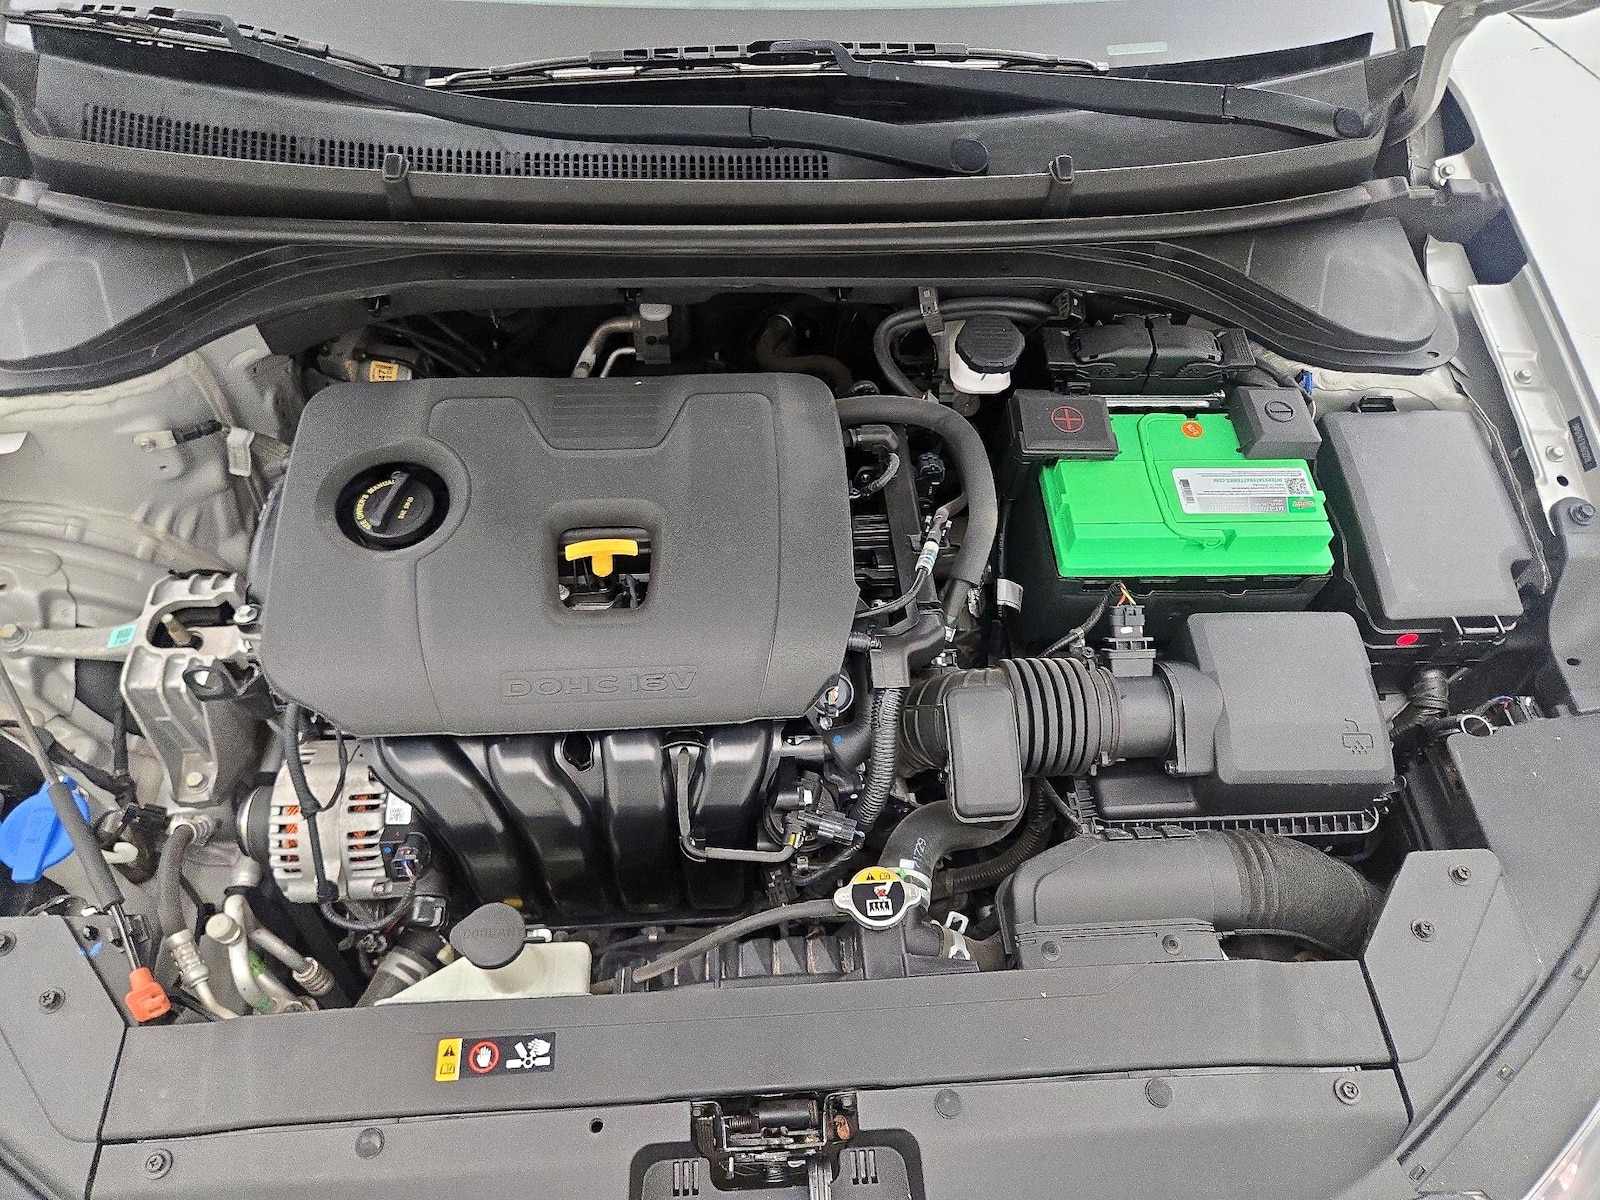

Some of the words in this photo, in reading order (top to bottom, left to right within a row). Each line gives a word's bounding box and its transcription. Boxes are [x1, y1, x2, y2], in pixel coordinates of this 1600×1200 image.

[360, 519, 372, 530] SEE
[504, 675, 619, 698] DOHC
[629, 671, 697, 692] 16V
